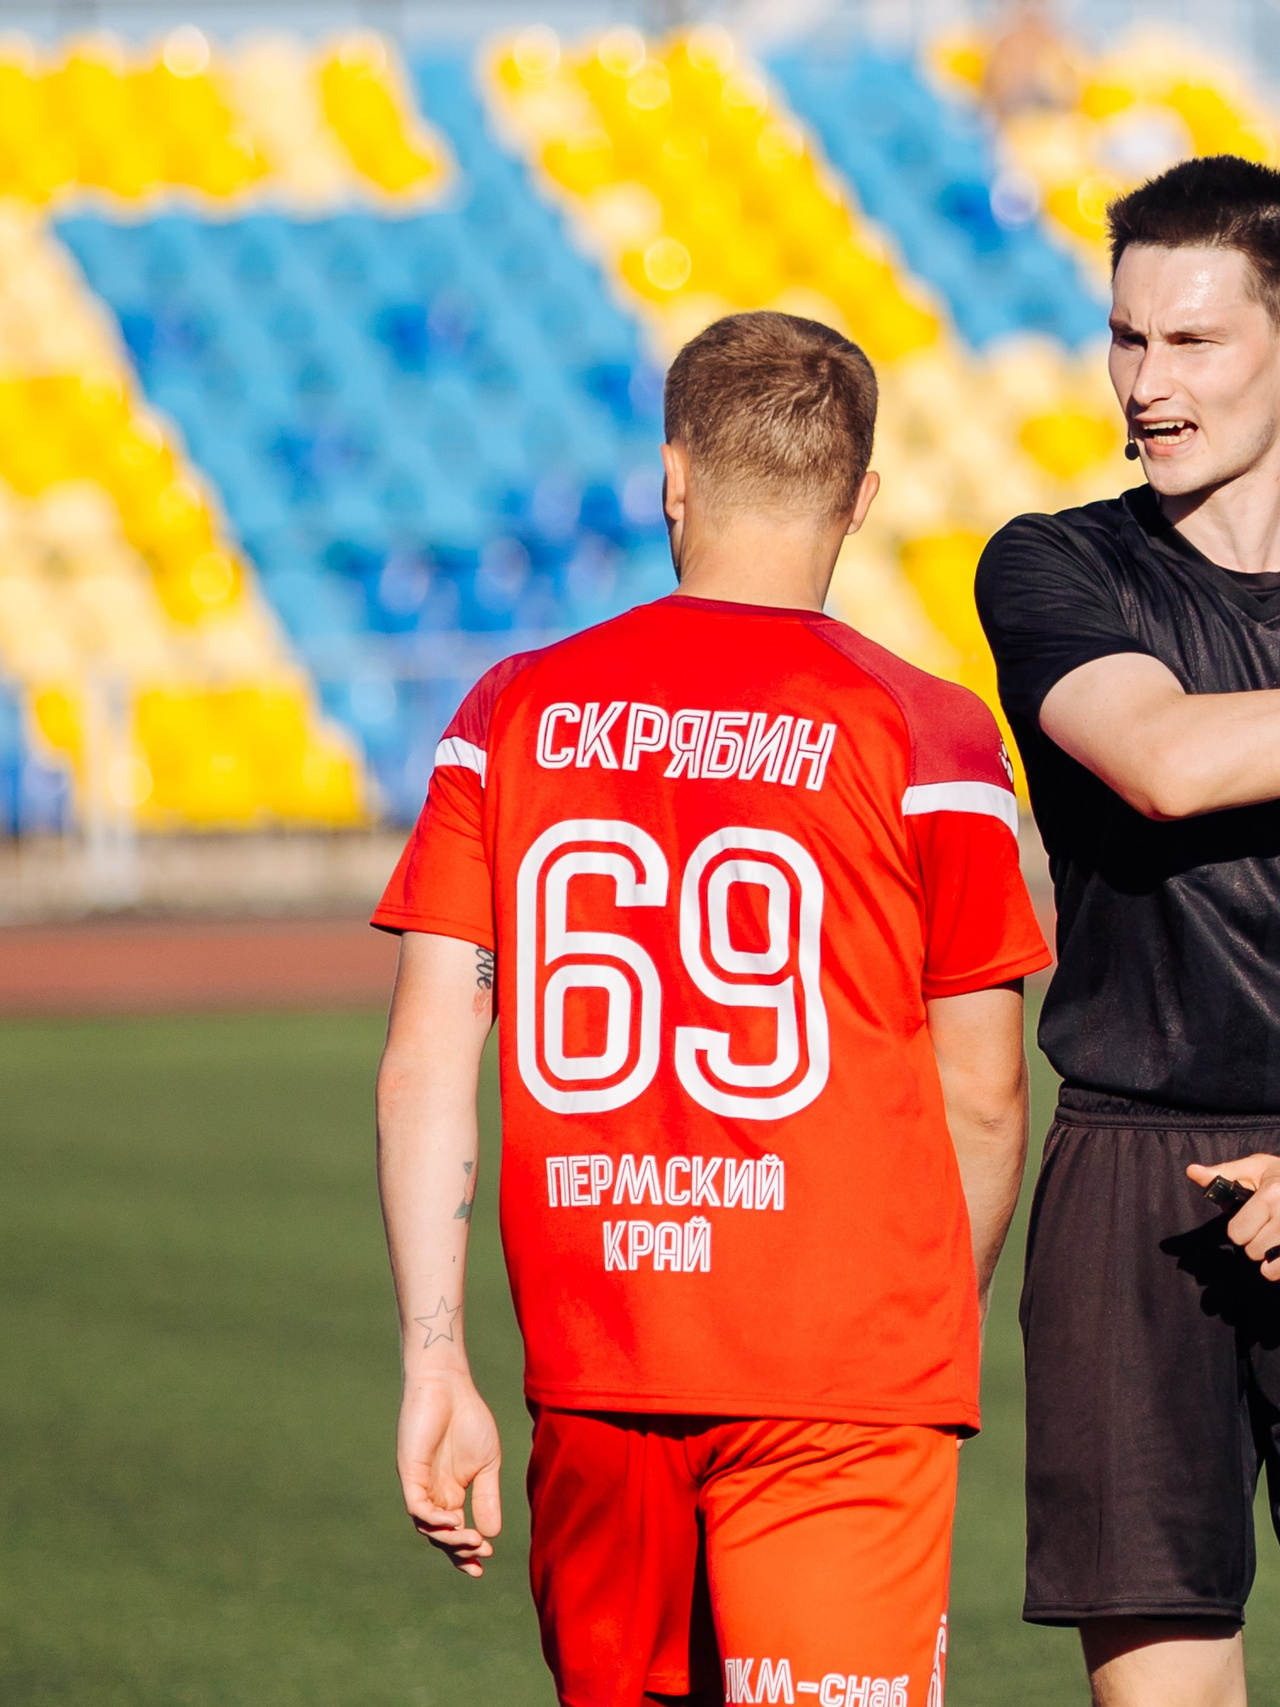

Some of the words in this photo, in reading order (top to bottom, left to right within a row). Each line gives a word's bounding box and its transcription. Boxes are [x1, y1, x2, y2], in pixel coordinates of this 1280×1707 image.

[537, 702, 836, 791] СКРЯБИН
[476, 946, 494, 989] ove
[517, 819, 830, 1120] 69
[547, 1154, 784, 1210] ПЕРМСКИЙ
[603, 1216, 711, 1273] КРАЙ
